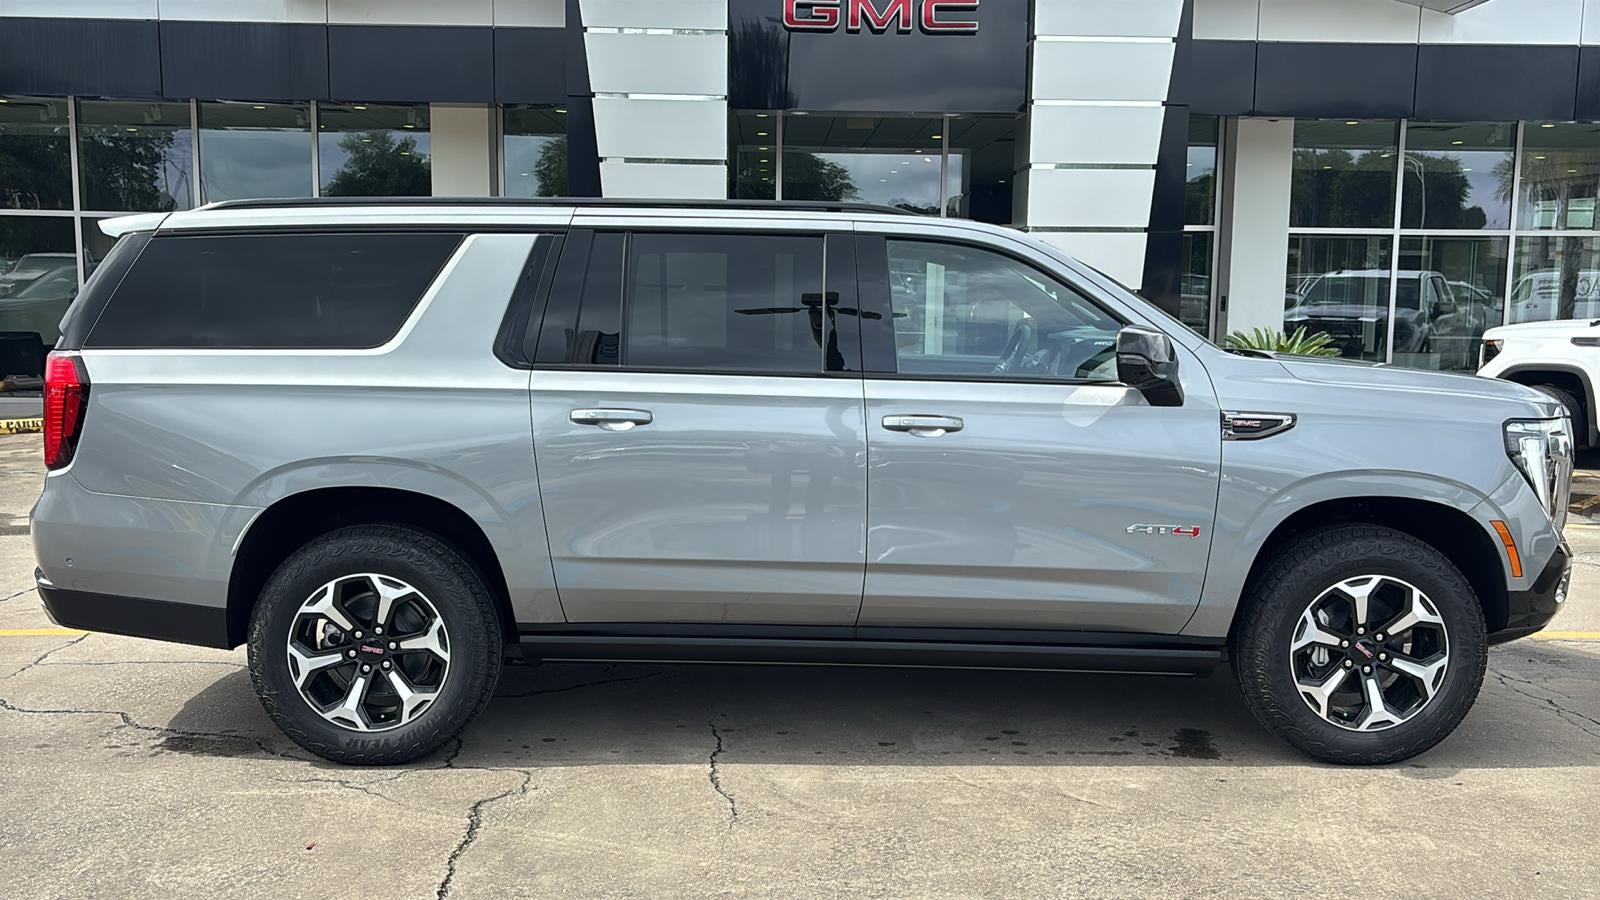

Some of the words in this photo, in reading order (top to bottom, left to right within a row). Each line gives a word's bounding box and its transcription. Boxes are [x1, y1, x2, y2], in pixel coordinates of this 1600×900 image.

[783, 0, 979, 32] GMC
[1127, 523, 1200, 538] AT4
[361, 645, 384, 655] GMC
